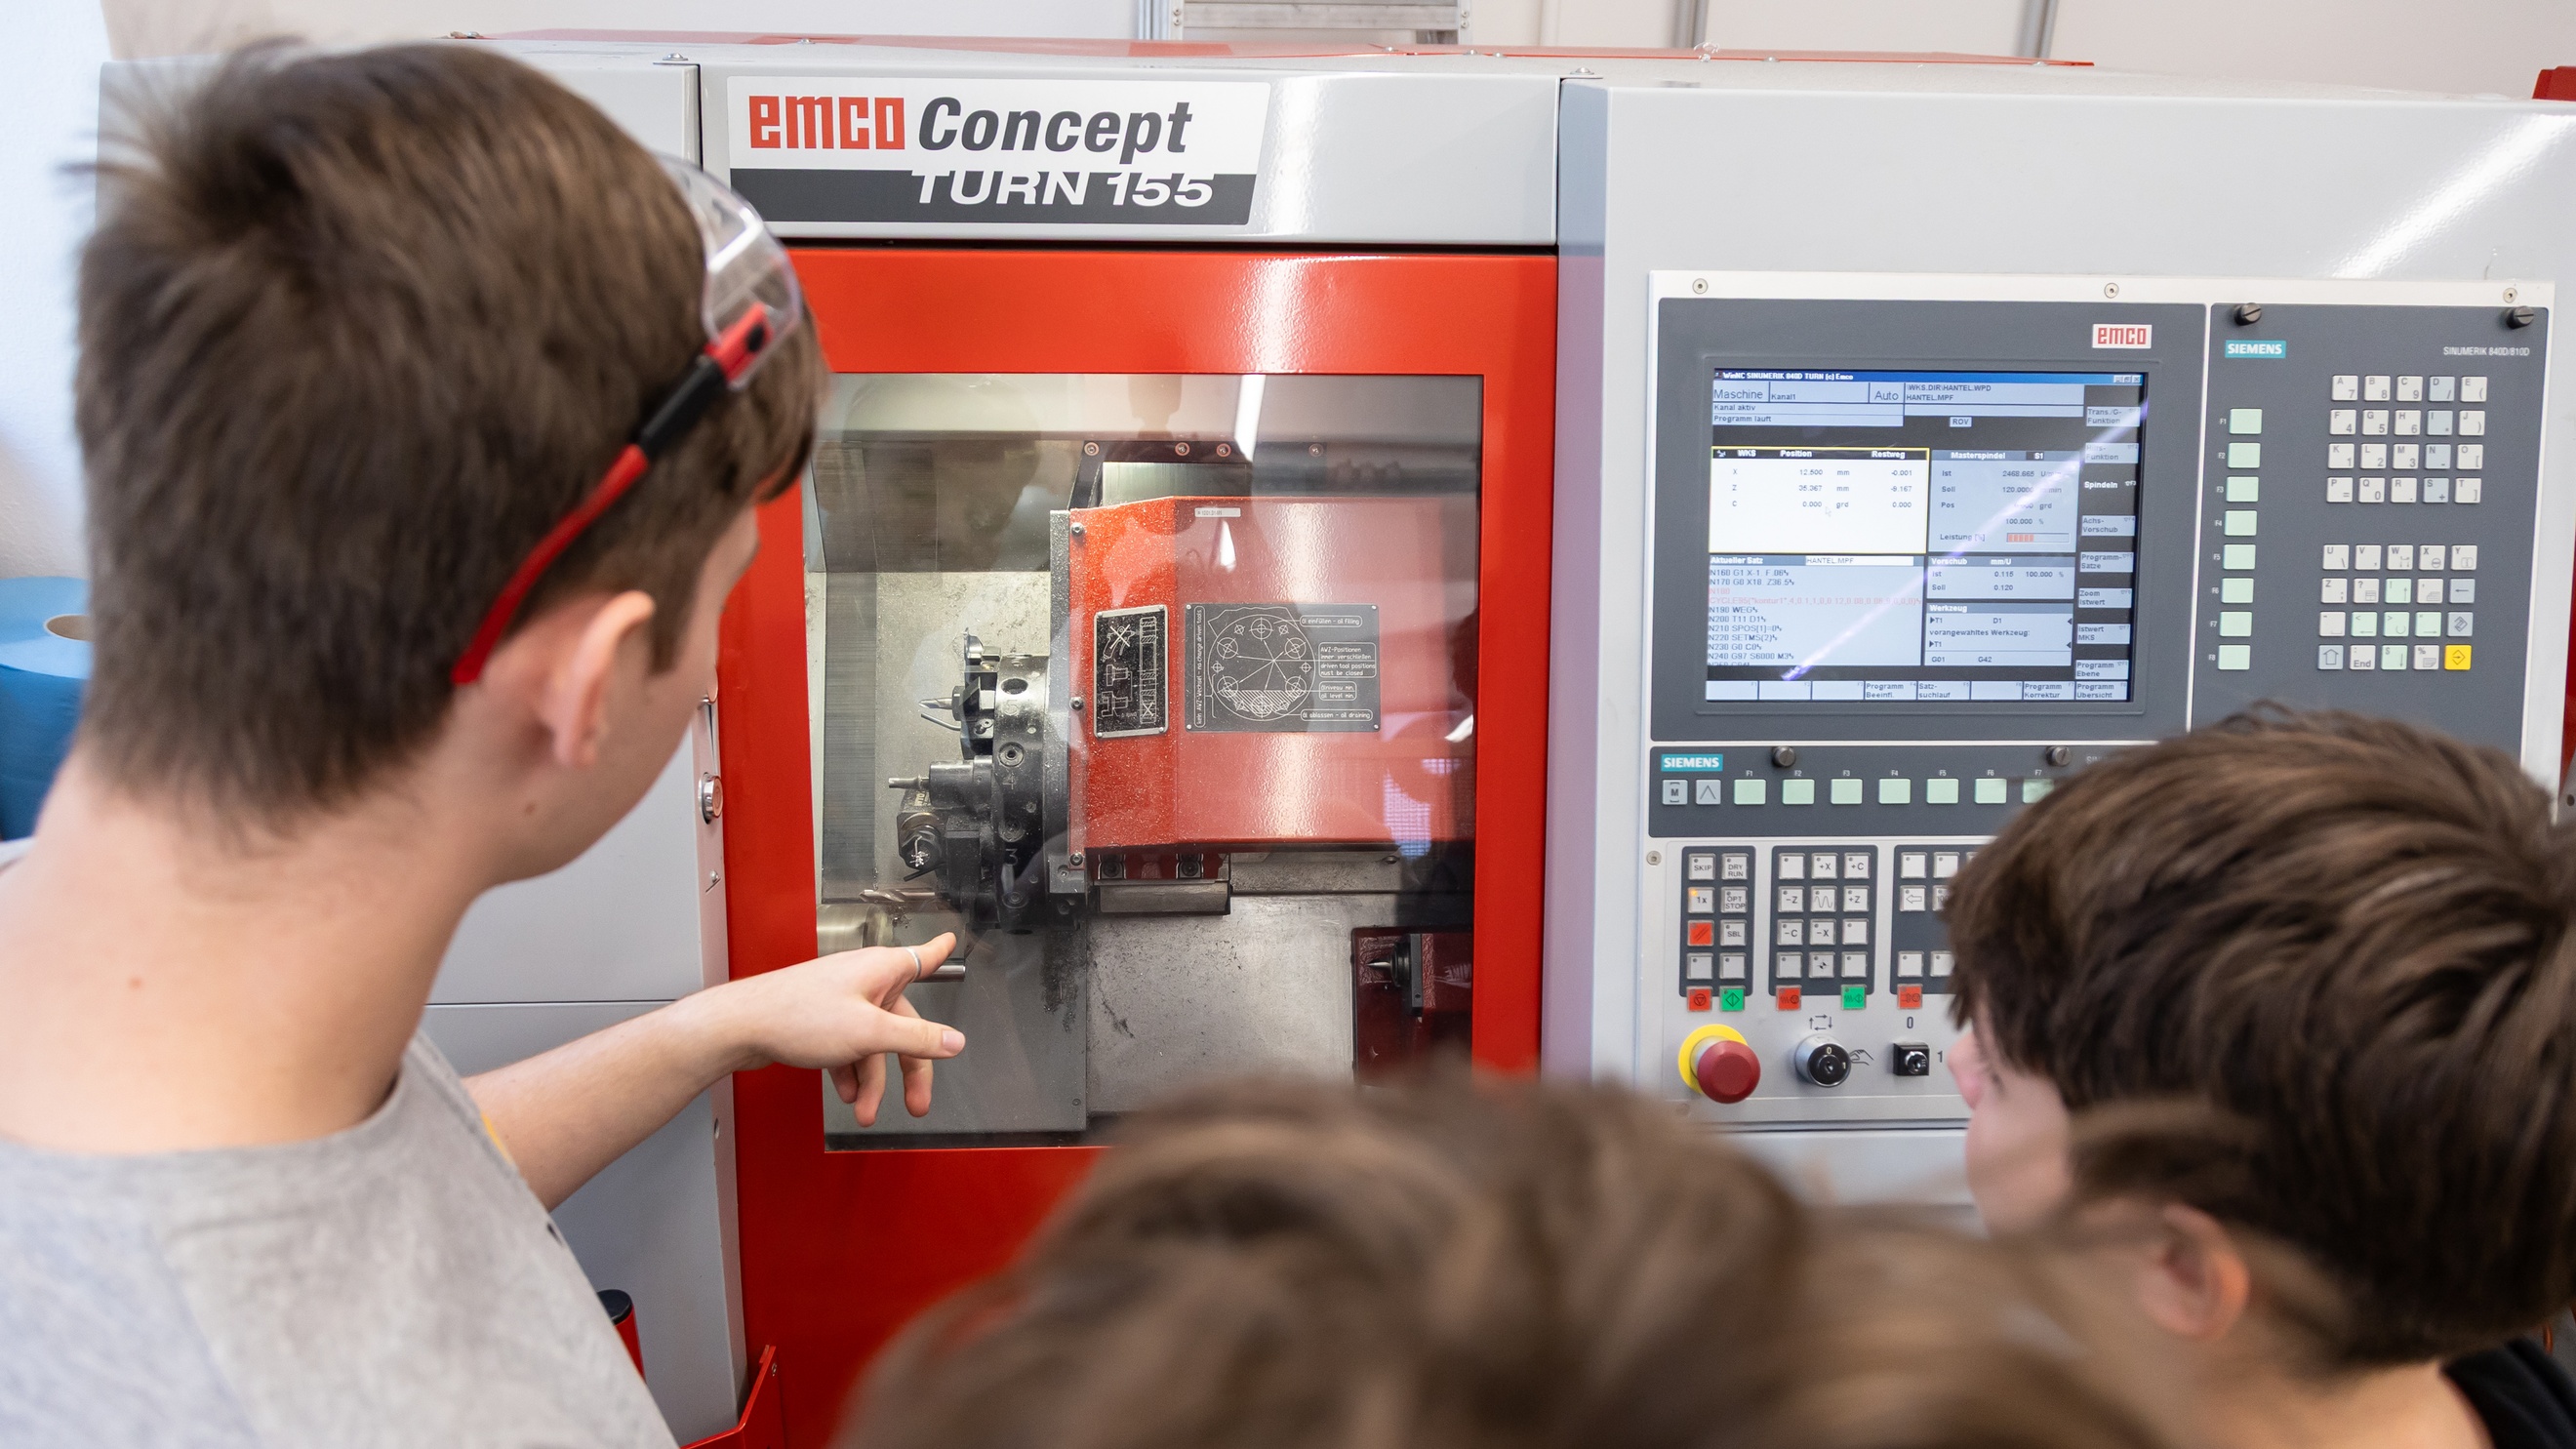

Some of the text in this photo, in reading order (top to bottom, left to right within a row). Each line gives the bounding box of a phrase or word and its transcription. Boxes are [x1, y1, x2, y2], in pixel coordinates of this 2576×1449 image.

[748, 95, 1192, 165] emco Concept
[911, 169, 1216, 209] TURN 155
[2097, 327, 2147, 345] emco
[2227, 343, 2283, 355] SIEMENS
[2442, 346, 2531, 357] SINUMERIK 840D/810D
[1713, 388, 1763, 400] Maschine
[1874, 390, 1899, 401] Auto
[2348, 389, 2355, 399] 7
[2381, 389, 2388, 399] 8
[2413, 390, 2419, 399] 9
[1737, 403, 1756, 412] aktiv
[1713, 415, 1751, 423] Programm
[1737, 449, 1756, 458] WKS
[1872, 450, 1906, 460] Restweg
[1951, 452, 2006, 461] Masterspindel
[2084, 481, 2118, 490] Spindeln
[1835, 501, 1849, 509] grd
[1710, 556, 1763, 565] Aktueller Satz
[1931, 557, 2012, 566] Vorschub mm/U
[1929, 604, 1967, 613] Werkzeug
[1991, 628, 2031, 637] Werkzeug:
[2076, 662, 2114, 670] Programm
[2354, 660, 2372, 668] End
[1005, 699, 1018, 716] 5
[1664, 757, 1720, 768] SIEMENS
[1005, 848, 1019, 865] 3
[1693, 864, 1712, 872] SKIP
[1819, 863, 1831, 871] +X
[1851, 863, 1865, 871] +C
[1696, 896, 1707, 905] 1x
[1848, 895, 1861, 904] +Z
[1906, 1016, 1914, 1028] 0
[1937, 1050, 1944, 1062] 1
